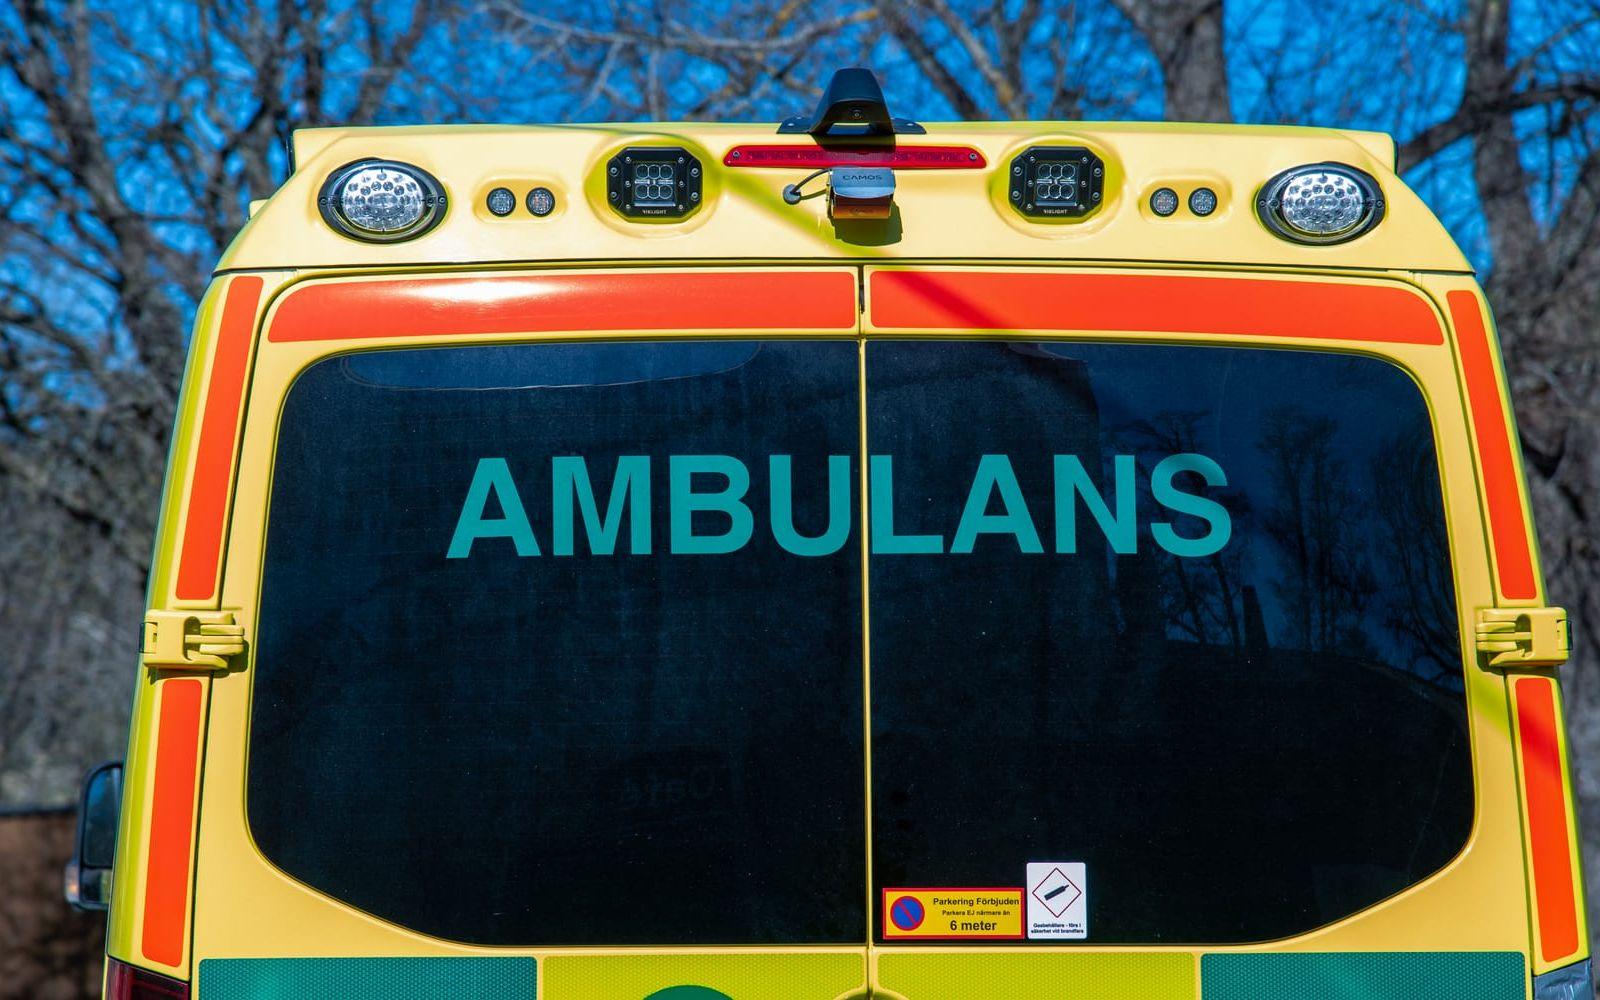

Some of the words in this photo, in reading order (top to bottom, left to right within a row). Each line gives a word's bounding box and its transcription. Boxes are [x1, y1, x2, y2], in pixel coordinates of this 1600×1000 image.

[446, 453, 1233, 559] AMBULANS
[933, 897, 974, 907] Parkering
[976, 897, 1020, 907] Förbjuden
[950, 920, 957, 931] 6
[961, 920, 997, 931] meter
